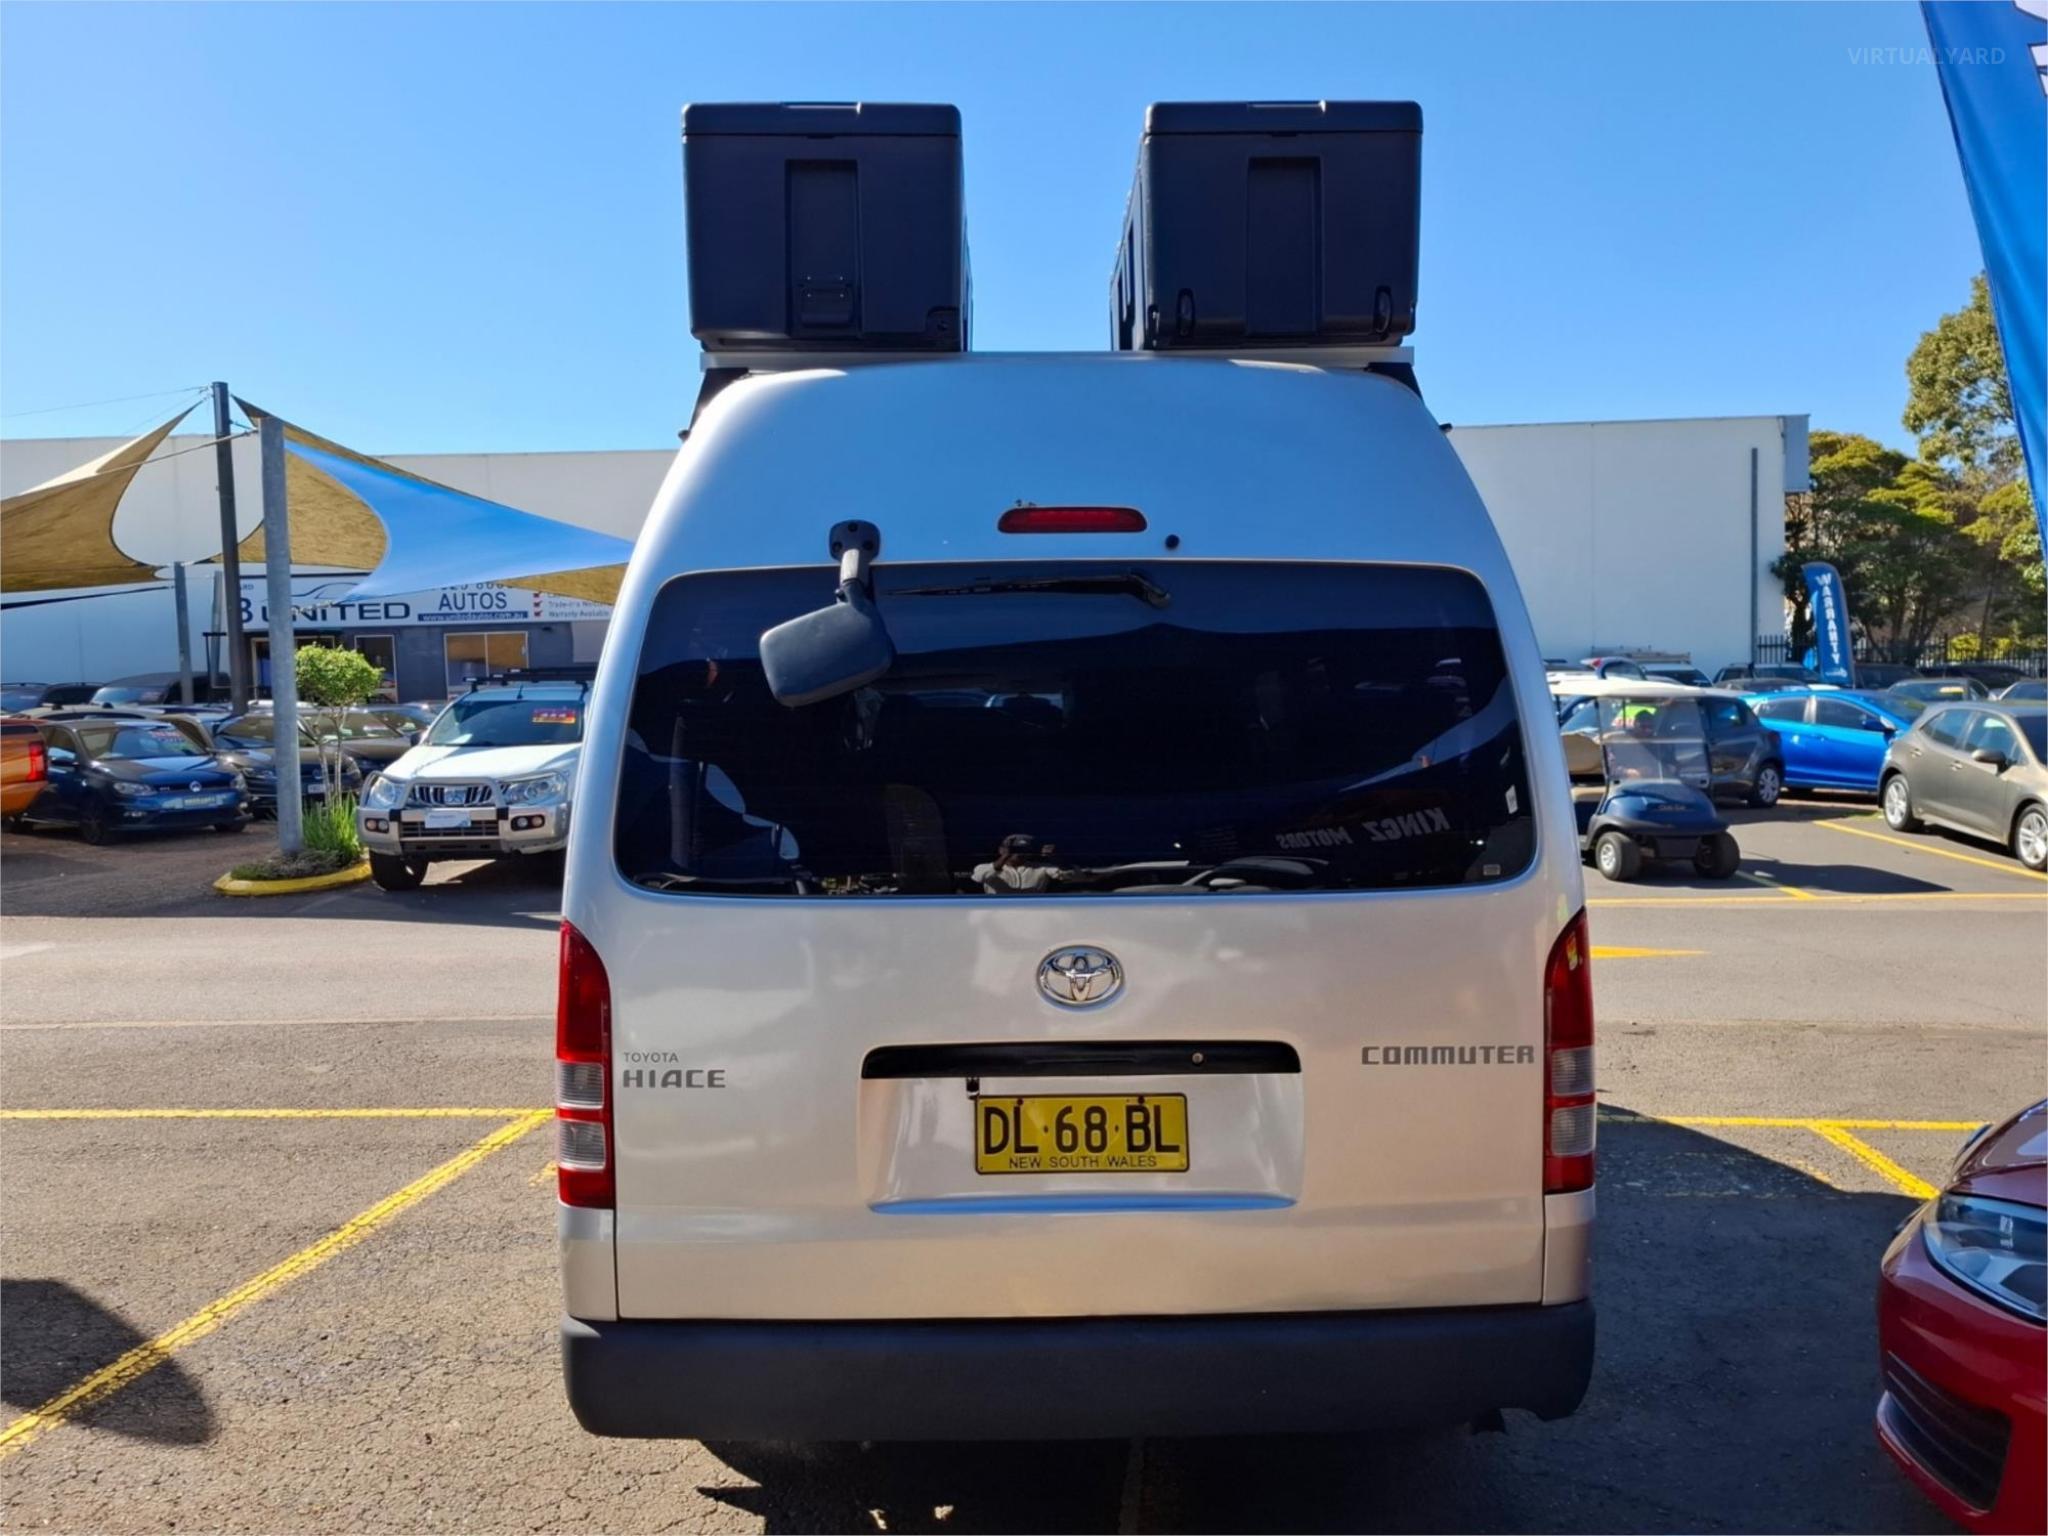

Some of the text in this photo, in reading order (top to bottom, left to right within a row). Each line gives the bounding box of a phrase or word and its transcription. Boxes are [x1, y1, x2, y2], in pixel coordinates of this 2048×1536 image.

[438, 592, 507, 611] AUTOS
[623, 1052, 679, 1063] TOYOTA
[1361, 1045, 1535, 1065] COMMUTER
[622, 1069, 726, 1089] HIACE
[1009, 1155, 1157, 1169] NEW SOUTH WALES
